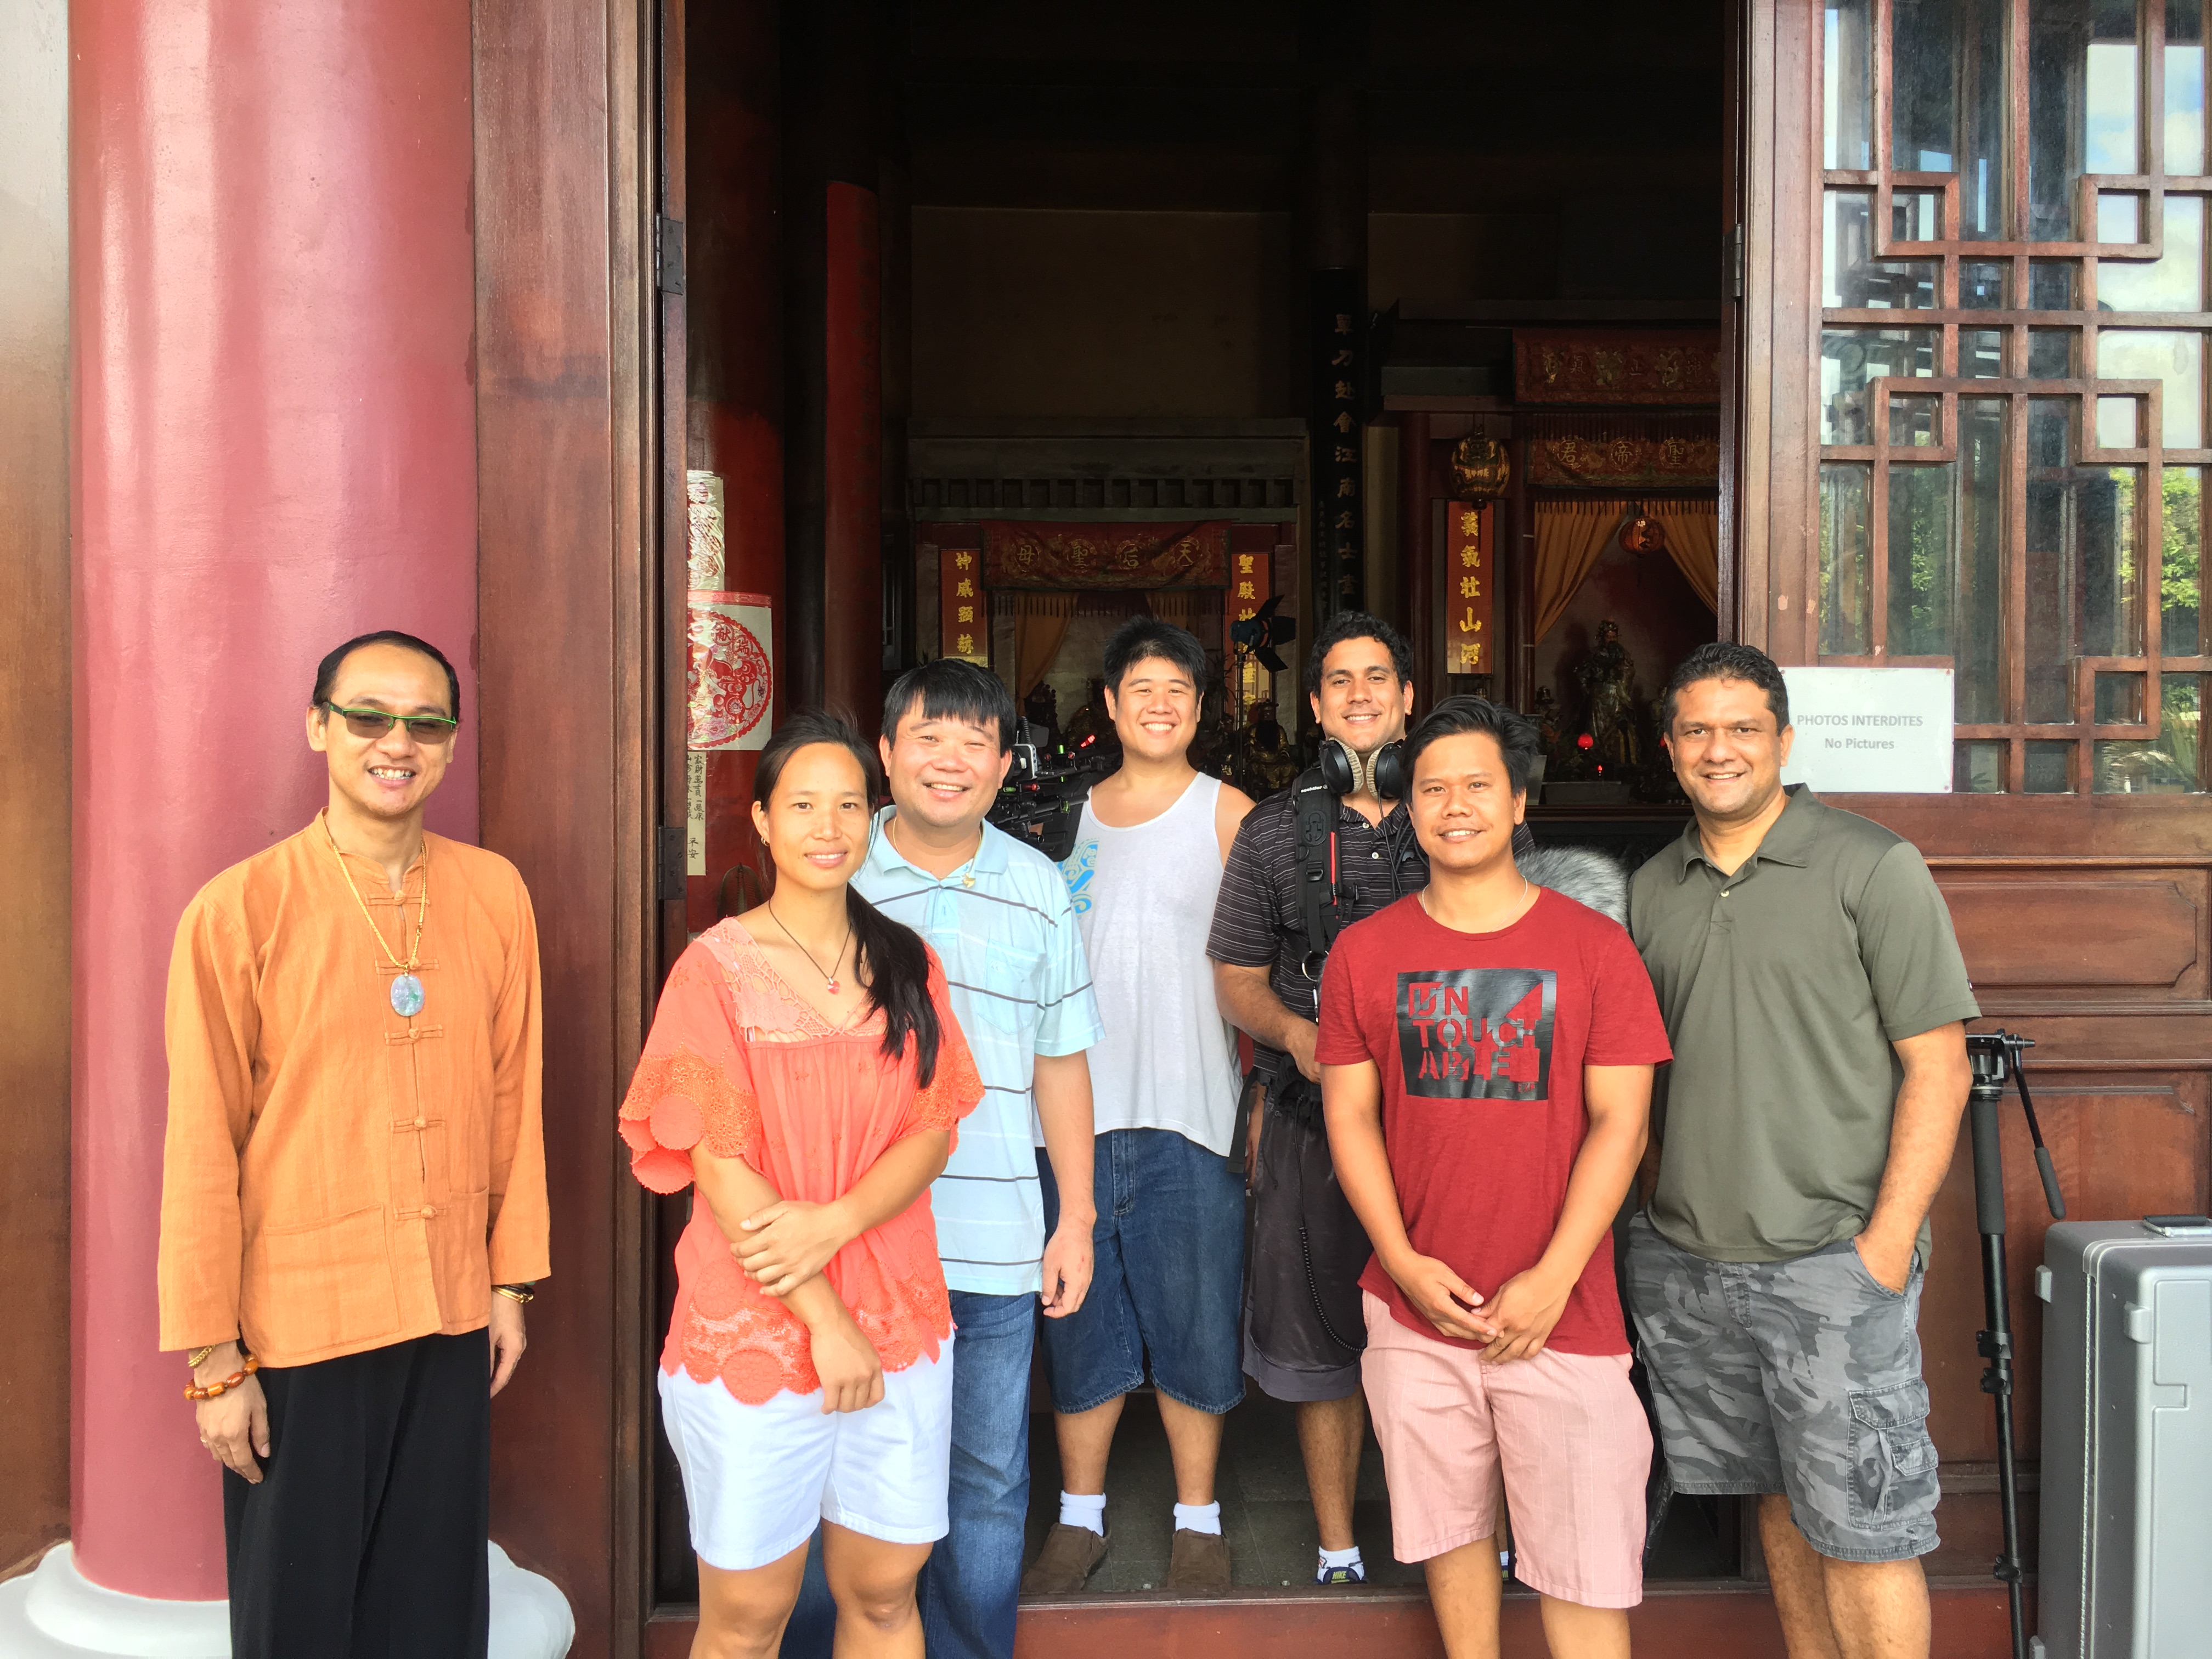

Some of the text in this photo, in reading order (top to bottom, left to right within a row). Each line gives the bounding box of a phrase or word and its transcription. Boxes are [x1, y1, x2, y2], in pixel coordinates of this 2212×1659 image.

[1797, 714, 1923, 727] PHOTOS INTERDITES
[1825, 737, 1895, 749] No Pictures
[1408, 981, 1469, 1019] UN
[1412, 1018, 1536, 1049] TOUCH
[1332, 1571, 1347, 1579] NIKE
